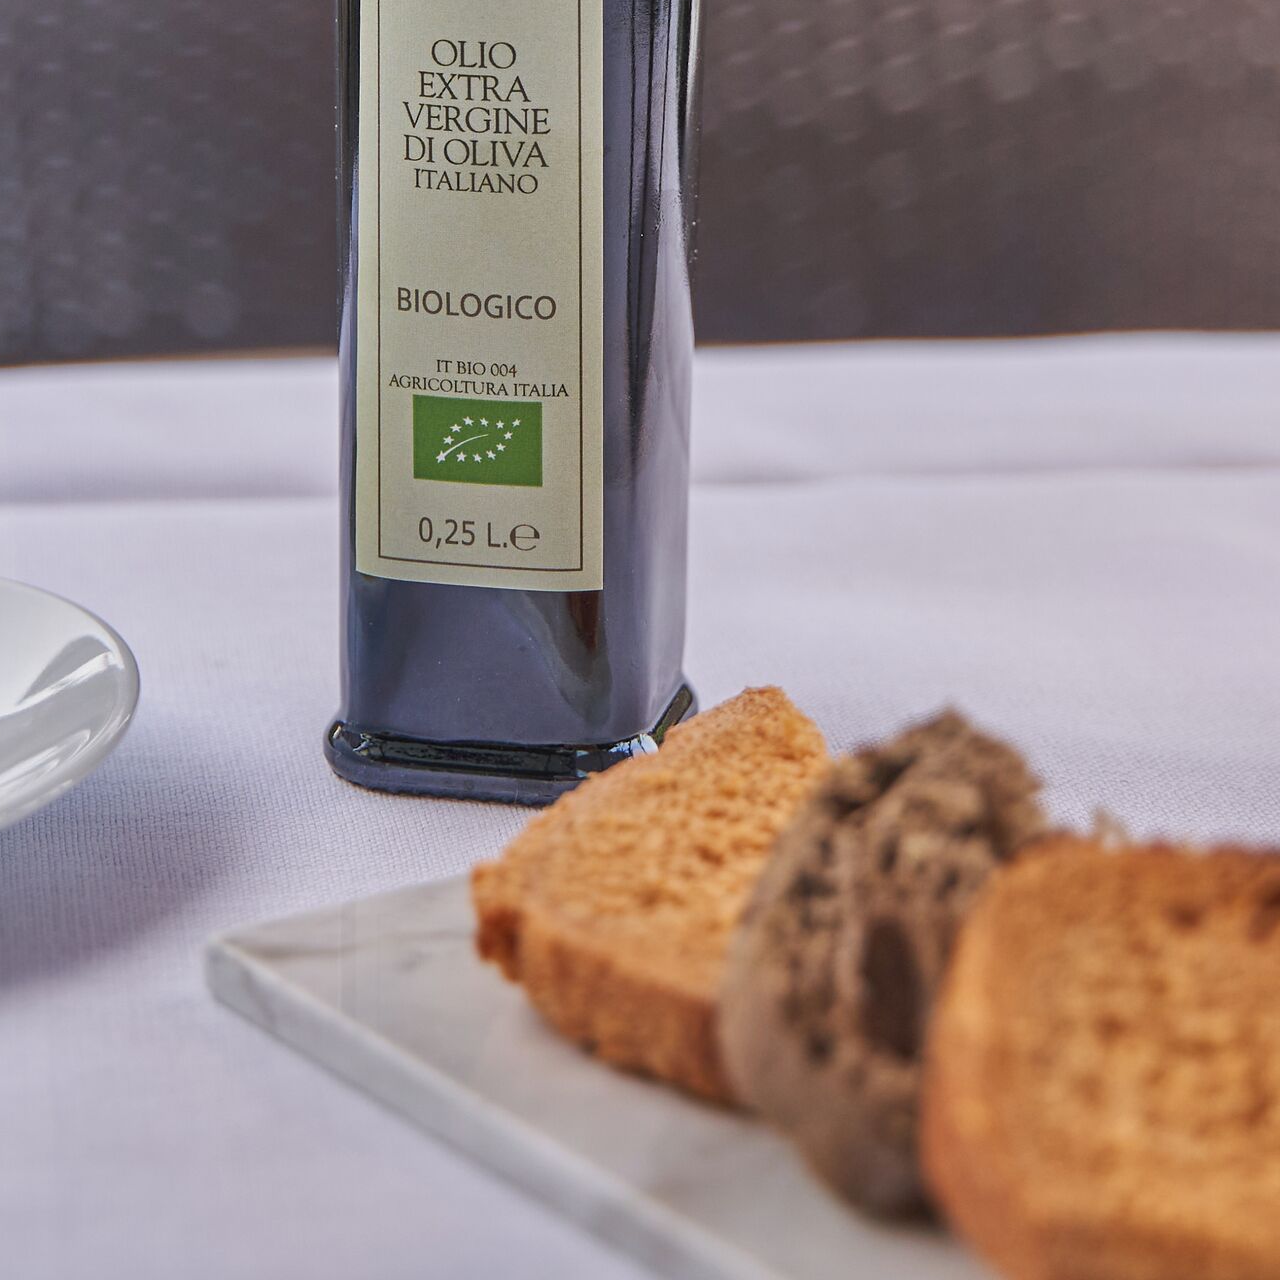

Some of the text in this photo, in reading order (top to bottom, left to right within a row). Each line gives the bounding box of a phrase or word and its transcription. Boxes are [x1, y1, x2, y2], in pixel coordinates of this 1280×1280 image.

[430, 38, 517, 70] OLIO
[417, 70, 532, 103] EXTRA
[402, 101, 552, 135] VERGINE
[403, 134, 550, 168] DI OLIVA
[413, 168, 539, 195] ITALIANO
[397, 286, 557, 321] BIOLOGICO
[388, 373, 570, 398] AGRICOLTURA ITALIA
[436, 359, 518, 379] IT BIO 004
[418, 516, 476, 550] 0,25
